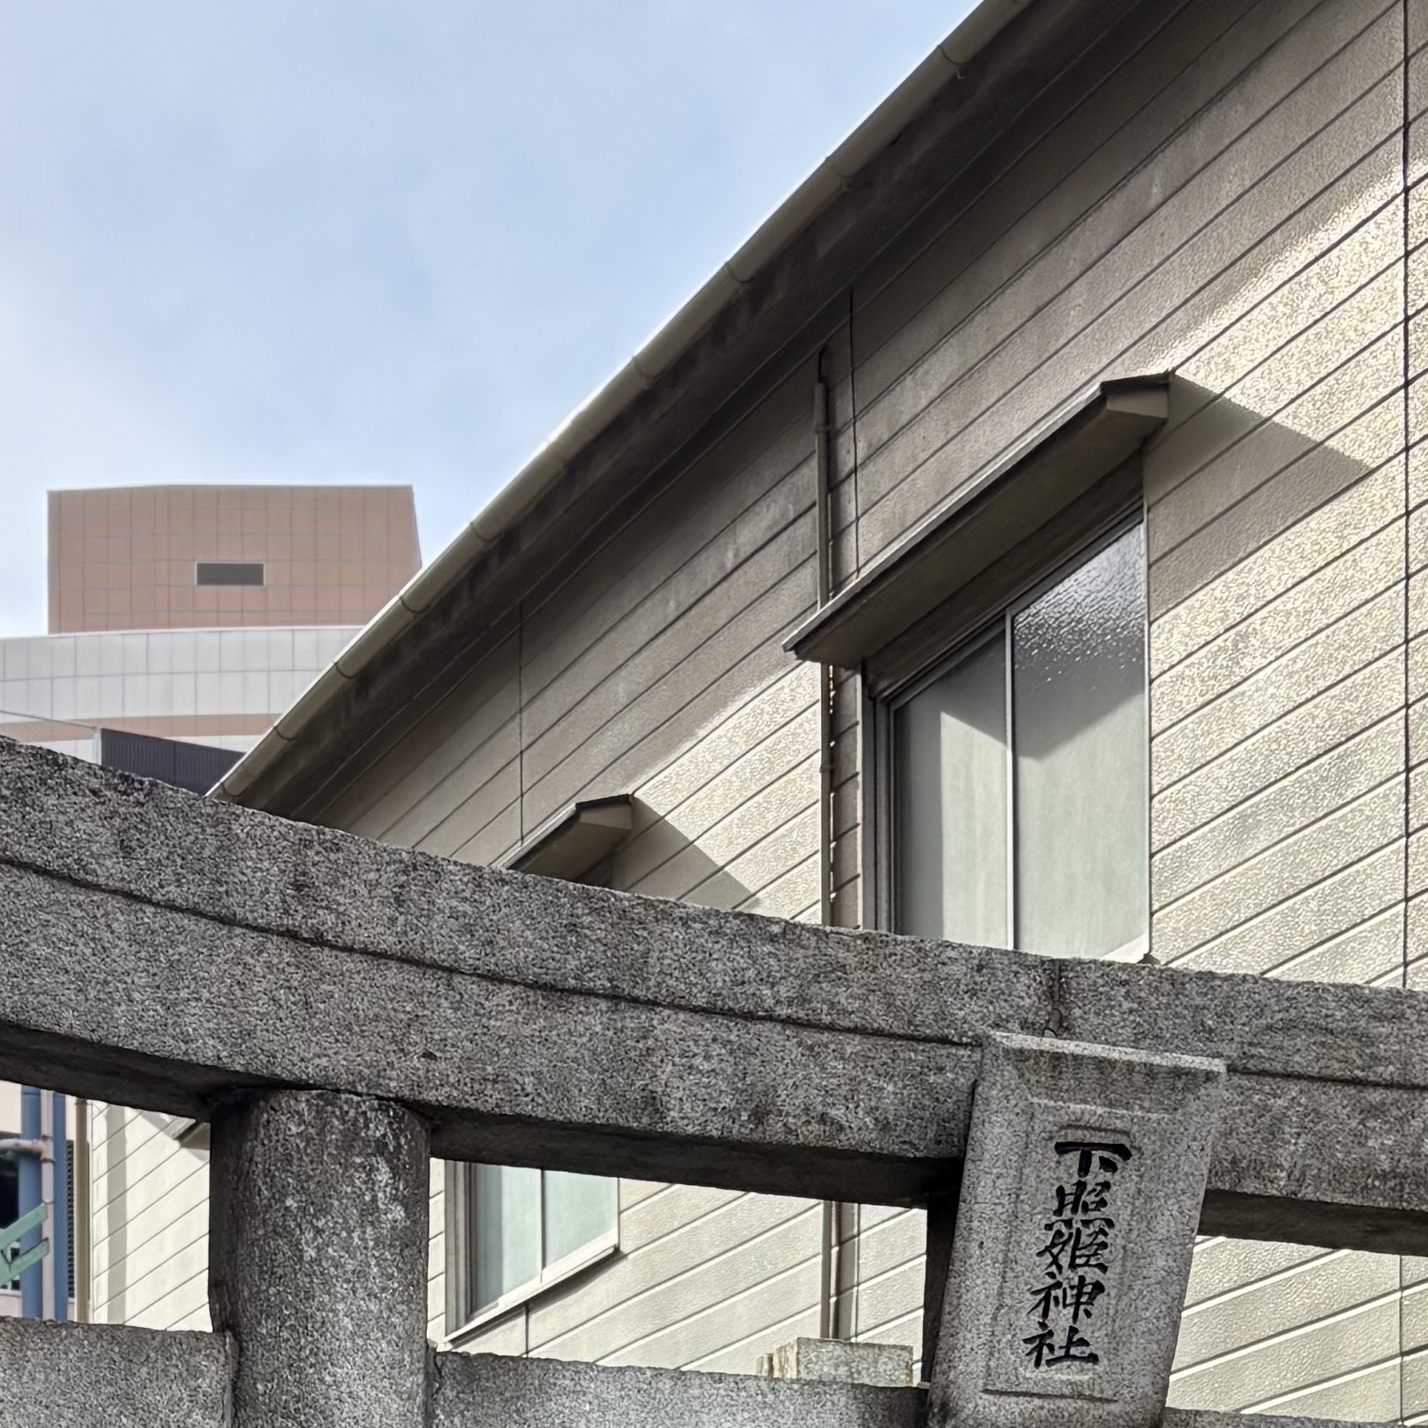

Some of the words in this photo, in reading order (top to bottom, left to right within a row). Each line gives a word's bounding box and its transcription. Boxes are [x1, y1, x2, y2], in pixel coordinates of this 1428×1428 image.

[1023, 1140, 1132, 1369] 下照姫神社
